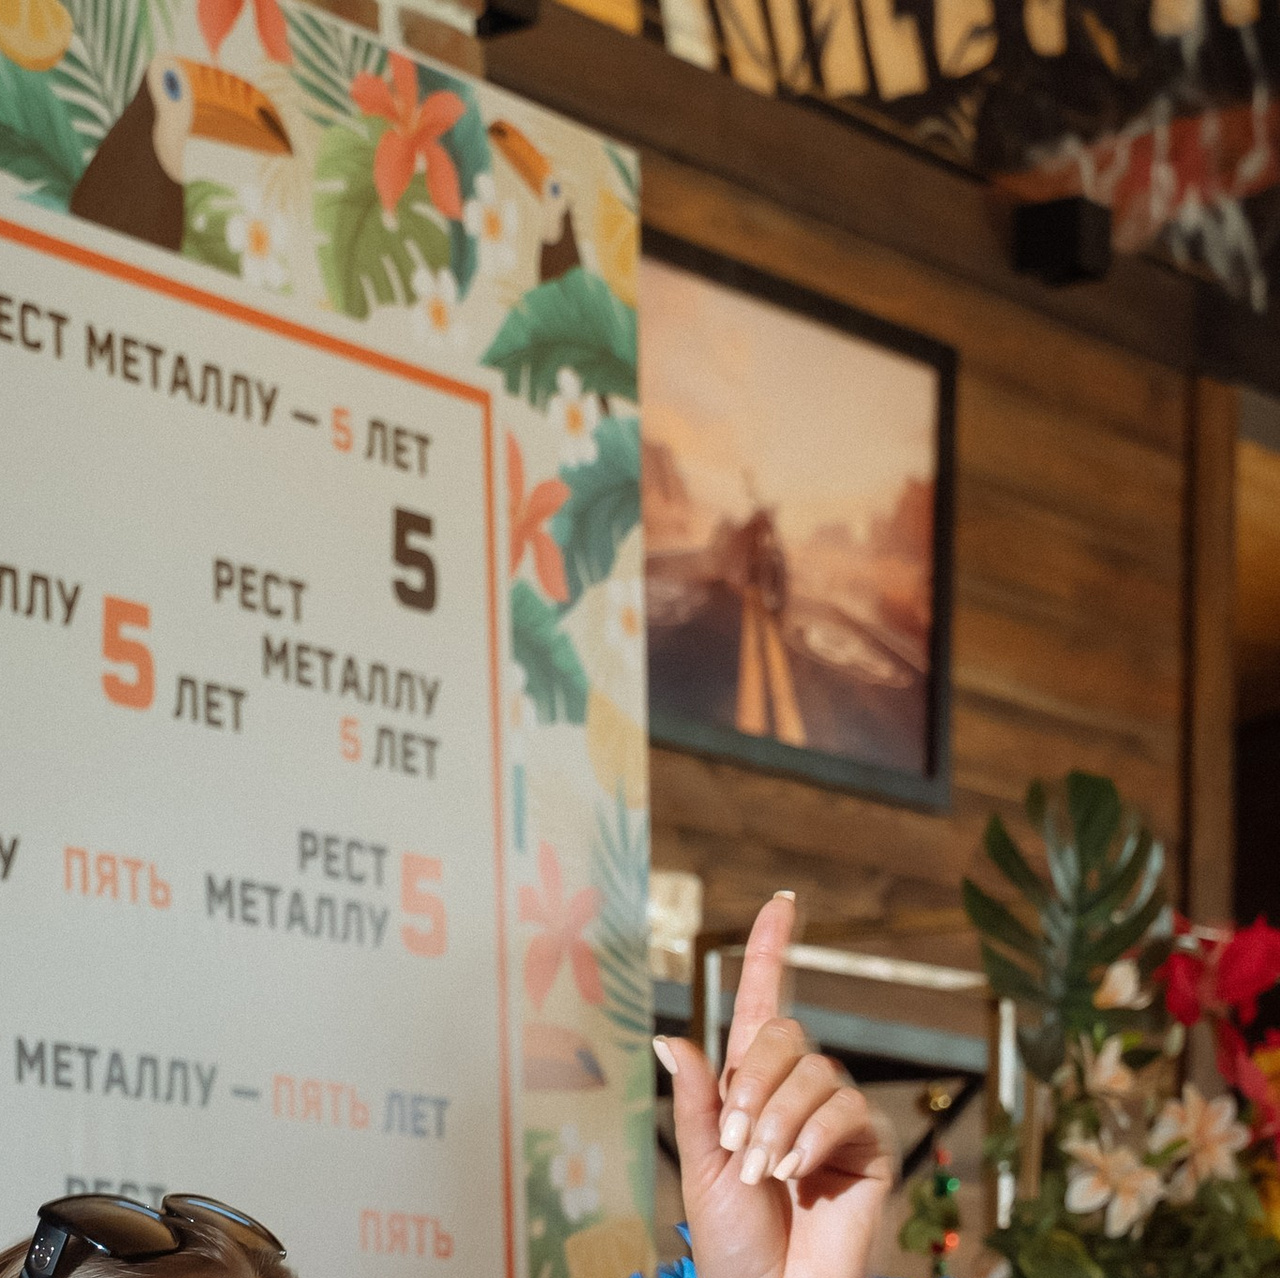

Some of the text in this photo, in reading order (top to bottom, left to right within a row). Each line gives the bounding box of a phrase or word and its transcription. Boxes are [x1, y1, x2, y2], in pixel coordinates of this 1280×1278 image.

[86, 322, 279, 427] МЕТАЛЛУ
[331, 406, 354, 453] 5
[365, 417, 432, 478] ЛЕТ
[214, 557, 308, 625] РЕСТ
[390, 506, 438, 614] 5
[102, 594, 249, 734] 5 ЛЕТ
[261, 633, 440, 720] МЕТАЛЛУ
[340, 716, 440, 780] 5 ЛЕТ
[64, 846, 172, 910] ПЯТЬ
[298, 829, 388, 888] РЕСТ
[205, 873, 389, 949] МЕТАЛЛУ
[400, 851, 448, 959] 5
[15, 1036, 218, 1110] МЕТАЛЛУ
[271, 1073, 371, 1131] ПЯТЬ
[383, 1089, 449, 1140] ЛЕТ
[359, 1208, 455, 1262] ПЯТЬ
